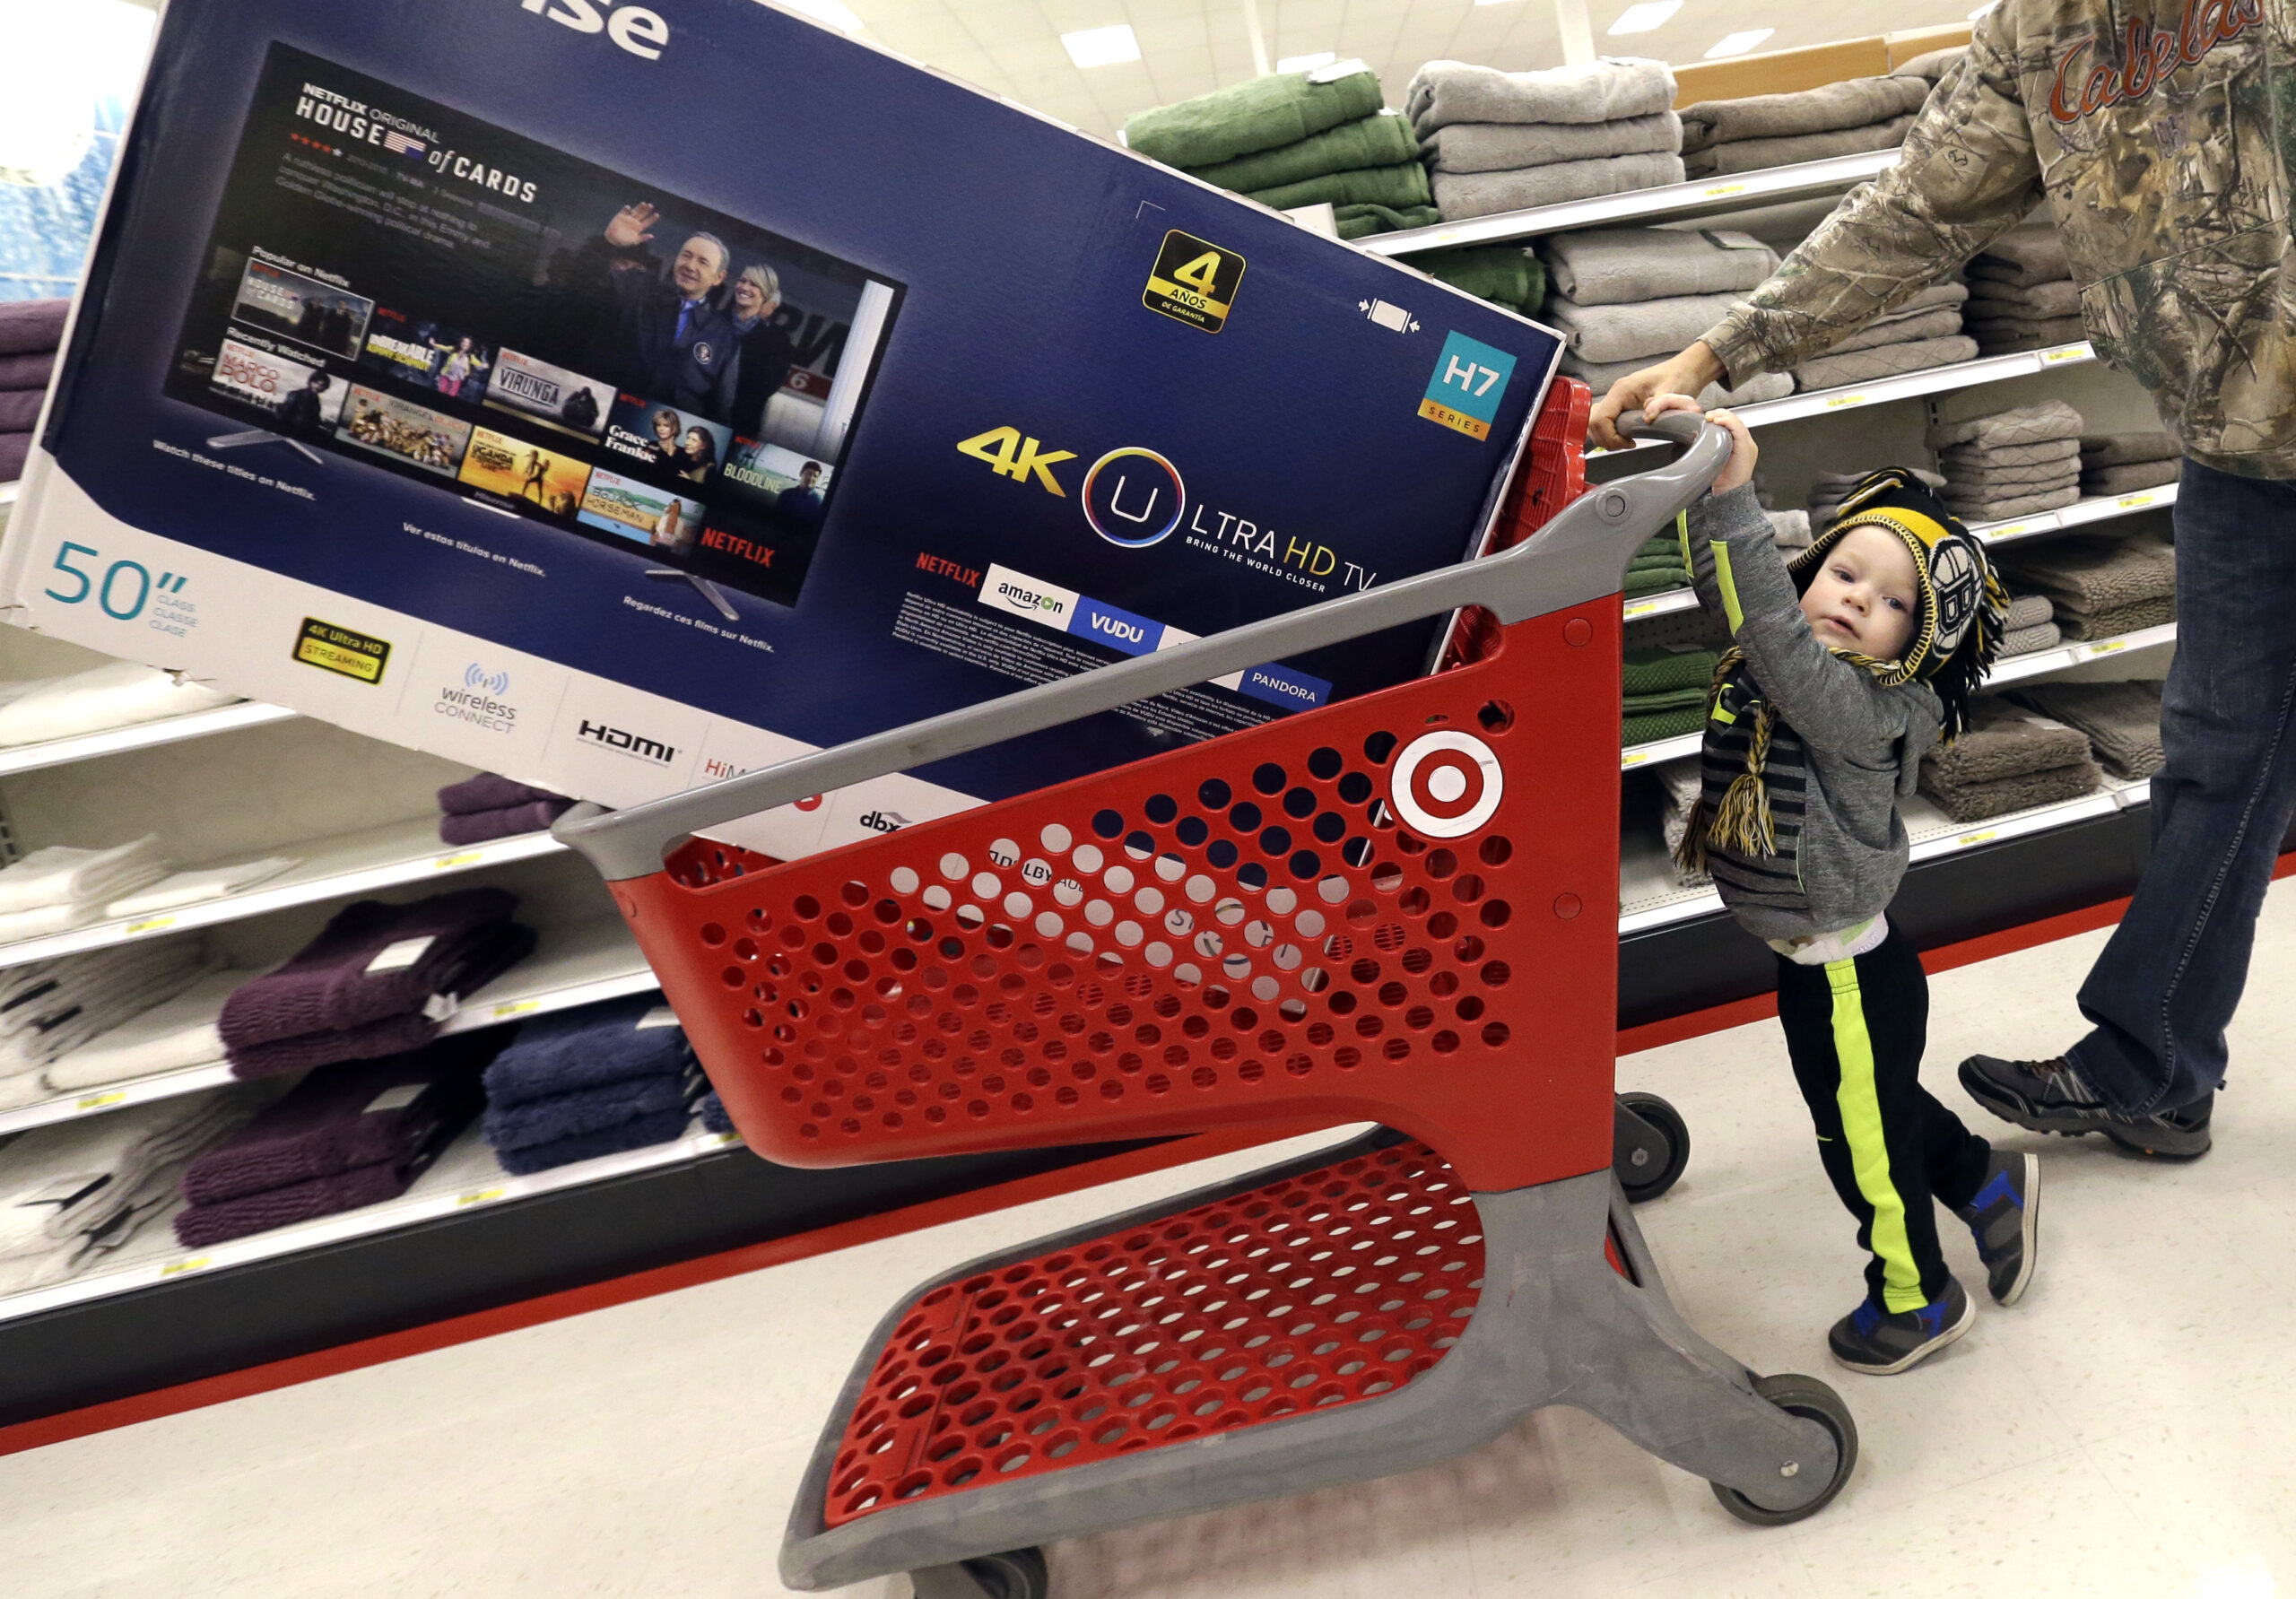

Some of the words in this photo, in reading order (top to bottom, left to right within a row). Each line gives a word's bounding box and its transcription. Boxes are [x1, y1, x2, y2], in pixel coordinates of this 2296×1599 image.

[302, 83, 368, 115] NETFLIX
[369, 108, 442, 143] ORIGINAL
[296, 96, 384, 144] HOUSE
[428, 144, 455, 175] of
[453, 155, 538, 204] CARDS
[251, 245, 297, 269] Popular
[296, 263, 313, 274] on
[313, 268, 351, 287] Netflix
[1174, 251, 1221, 297] 4
[1161, 301, 1171, 309] DE
[1172, 305, 1205, 323] GARANTÍA
[1169, 289, 1207, 309] AÑOS
[226, 326, 276, 352] Recently
[276, 344, 326, 367] Watched
[220, 364, 275, 393] POLO
[498, 369, 560, 404] VIRUNGA
[1442, 355, 1500, 397] H7
[1428, 404, 1481, 433] SERIES
[605, 436, 657, 463] Frankie
[608, 423, 649, 448] Grace
[152, 439, 191, 459] Watch
[191, 453, 225, 470] these
[226, 464, 257, 481] titles
[257, 476, 274, 486] on
[275, 480, 317, 500] Netflix.
[724, 463, 781, 493] BLOODLINE
[586, 496, 643, 523] HORSEMAN
[957, 426, 1077, 498] 4K
[1283, 535, 1335, 576] HD
[1344, 561, 1378, 592] TV
[402, 522, 422, 535] Ver
[423, 530, 455, 546] estos
[491, 553, 506, 563] en
[508, 558, 547, 577] Netflix.
[702, 527, 774, 567] NETFLIX
[1186, 535, 1218, 553] BRING
[1222, 549, 1242, 562] THE
[1247, 558, 1283, 577] WORLD
[1286, 572, 1325, 592] CLOSER
[916, 552, 982, 588] NETFLIX
[156, 594, 194, 612] CLASS
[998, 579, 1064, 615] amazon
[149, 619, 186, 637] CLASE
[152, 606, 197, 627] CLASSE
[622, 595, 673, 620] Regardez
[674, 614, 692, 625] ces
[694, 620, 718, 634] films
[720, 630, 736, 640] sur
[739, 634, 776, 653] Netflix.
[1089, 611, 1144, 644] VUDU
[308, 623, 327, 638] 4K
[329, 630, 361, 647] Ultra
[363, 640, 383, 655] HD
[305, 644, 372, 672] STREAMING
[441, 684, 517, 719] wireless
[1252, 672, 1318, 703] PANDORA
[434, 701, 513, 734] CONNECT
[859, 811, 901, 833] dbx
